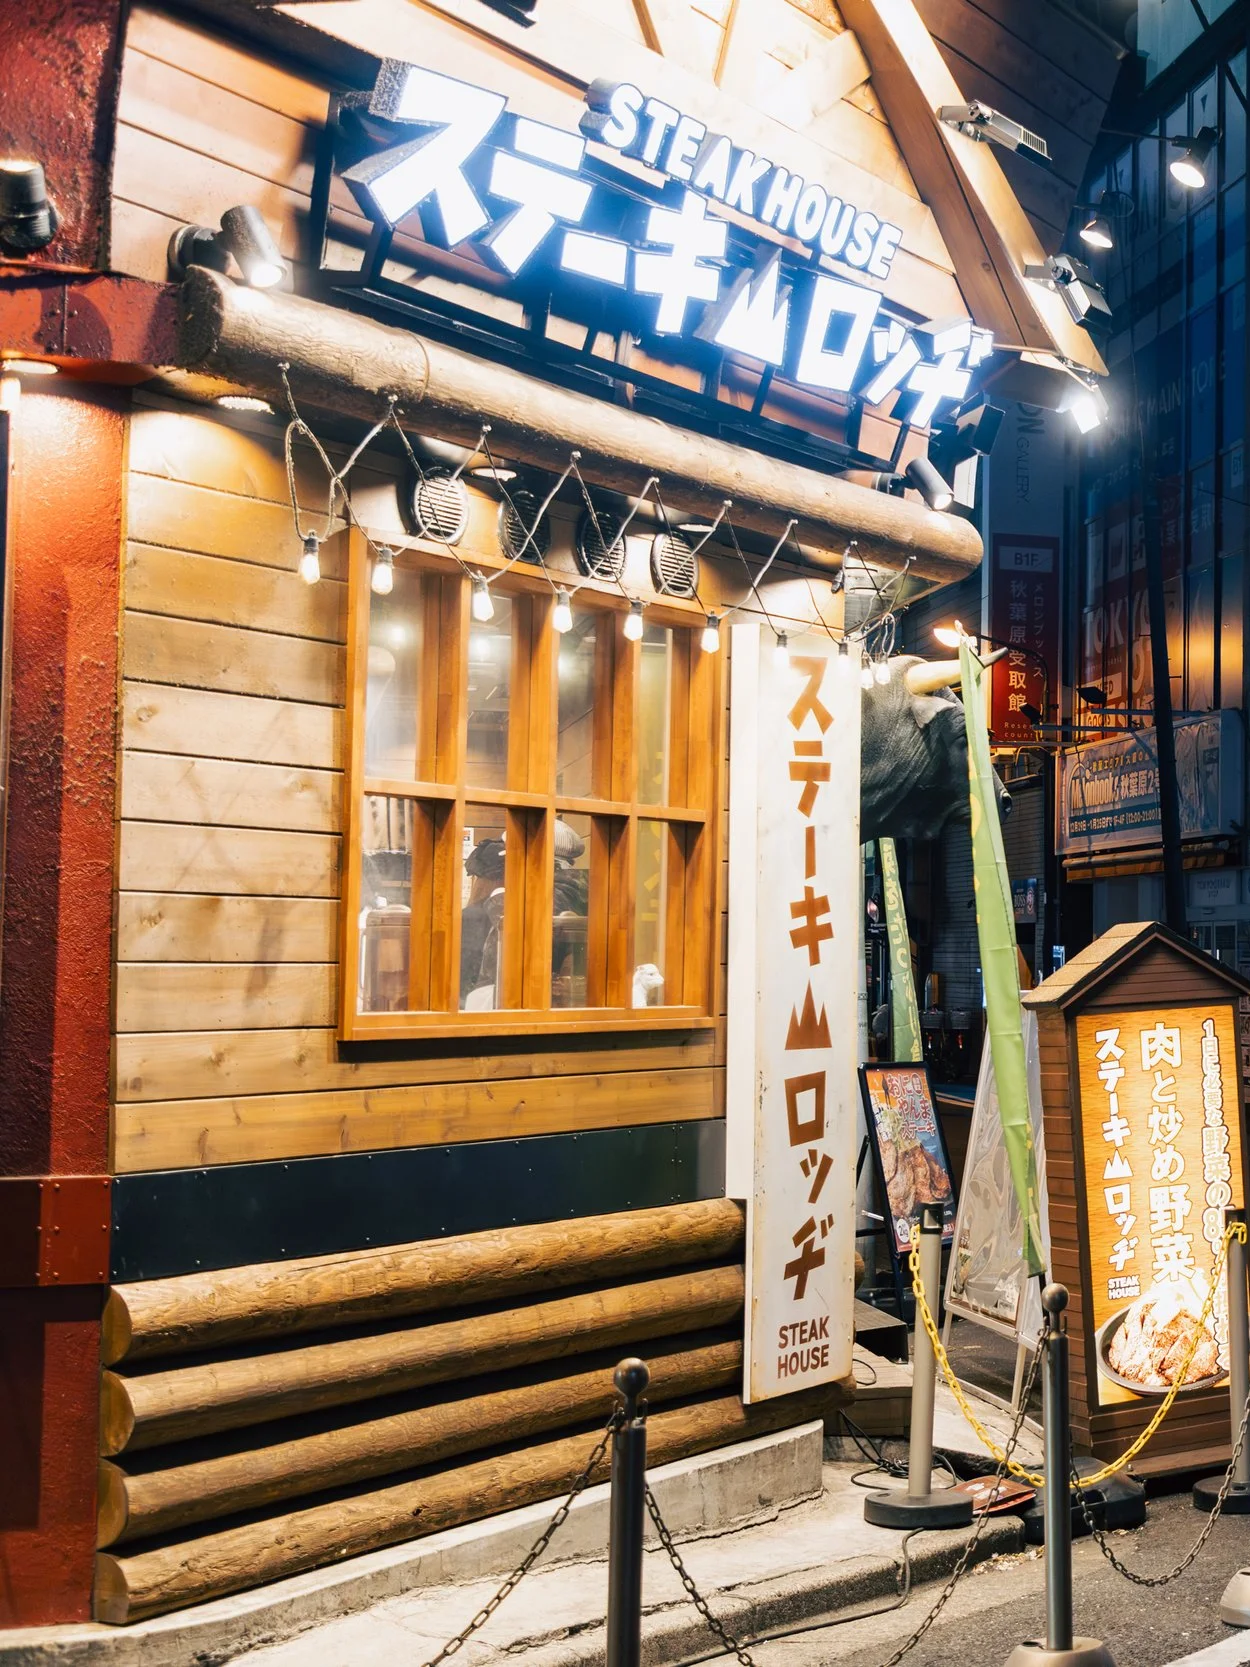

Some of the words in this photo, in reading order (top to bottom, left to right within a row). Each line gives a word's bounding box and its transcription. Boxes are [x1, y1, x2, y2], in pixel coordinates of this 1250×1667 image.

[1014, 552, 1039, 567] B1F
[1008, 579, 1027, 713] 秋葉原受取館
[786, 655, 835, 967] ステーキ
[1095, 1027, 1133, 1148] ステーキ
[783, 1070, 835, 1301] ロッヂ
[1140, 1021, 1196, 1284] 肉と炒め野菜
[1103, 1182, 1139, 1273] ロッヂ
[1108, 1274, 1140, 1289] STEAK
[1108, 1285, 1141, 1301] HOUSE
[777, 1345, 830, 1380] HOUSE
[778, 1315, 830, 1350] STEAK
